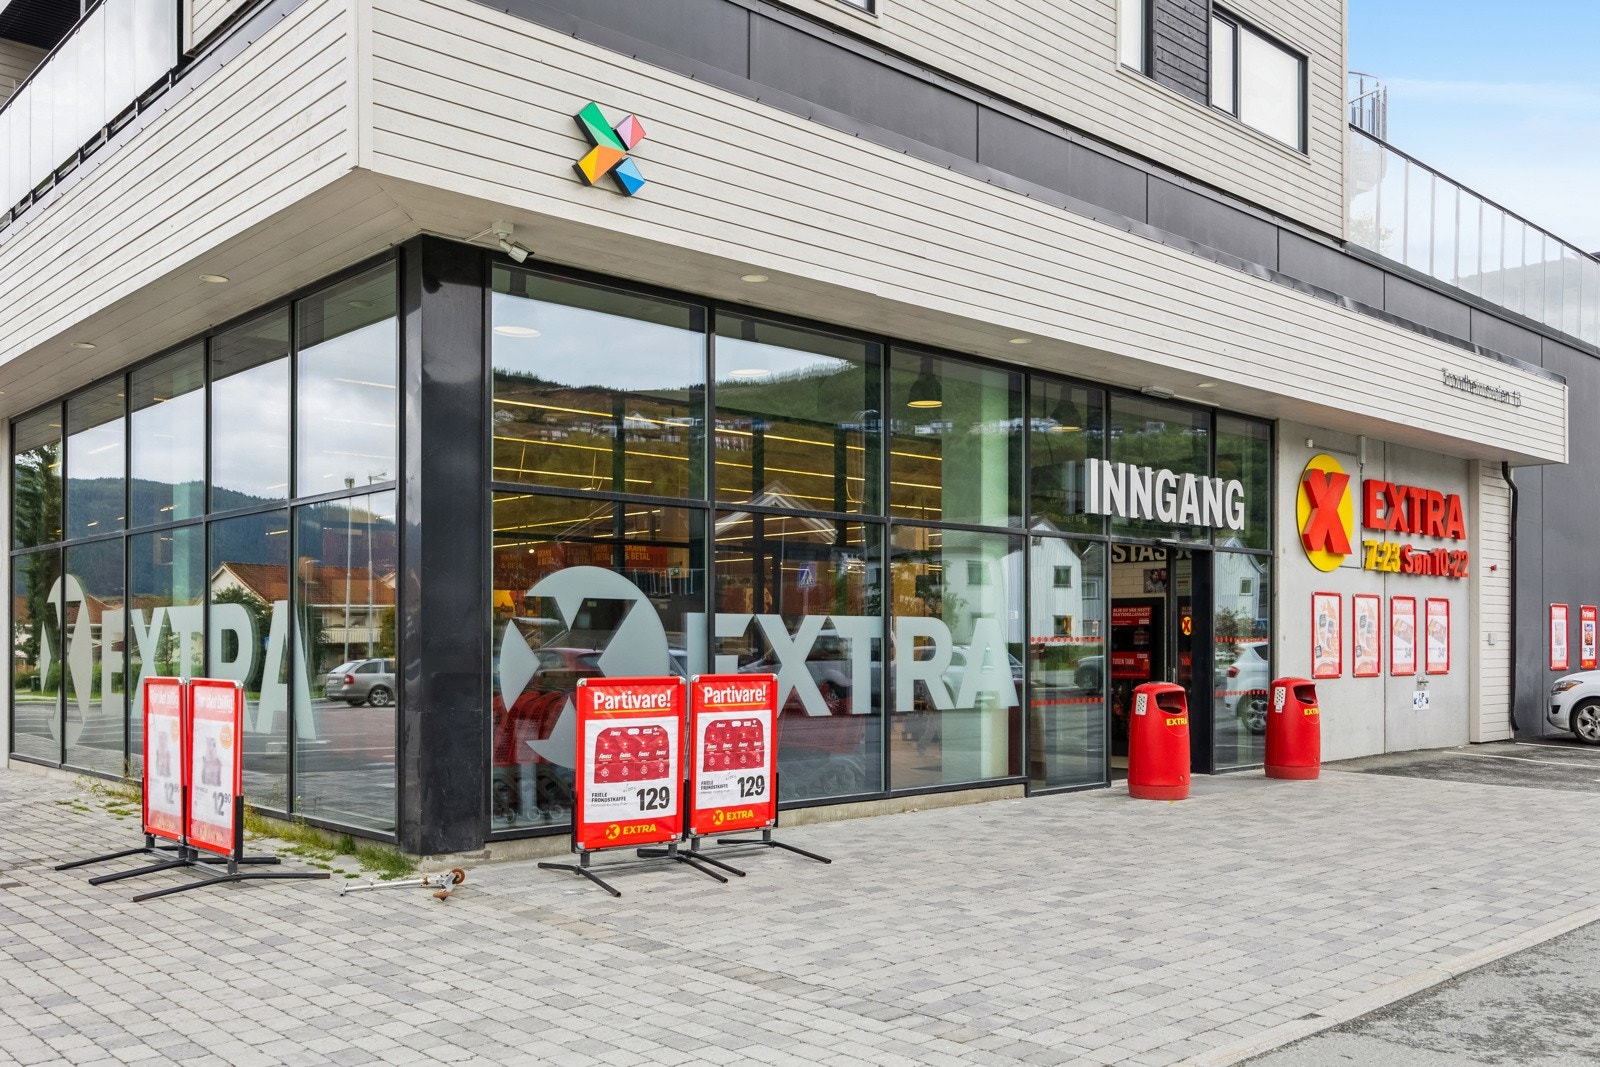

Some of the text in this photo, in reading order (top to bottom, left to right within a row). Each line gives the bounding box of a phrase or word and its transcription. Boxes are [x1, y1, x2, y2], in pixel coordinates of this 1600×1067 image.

[1085, 458, 1245, 530] INNGANG
[1363, 479, 1466, 540] EXTRA
[1363, 540, 1468, 577] 7-23 Søn 10-22
[101, 600, 317, 740] EXTRA
[686, 613, 1020, 717] EXTRA
[593, 689, 672, 710] Partivare!
[704, 685, 767, 704] Partivare!
[636, 786, 671, 811] 129
[737, 775, 766, 798] 129
[726, 809, 754, 821] EXTRA
[623, 824, 656, 835] EXTRA
